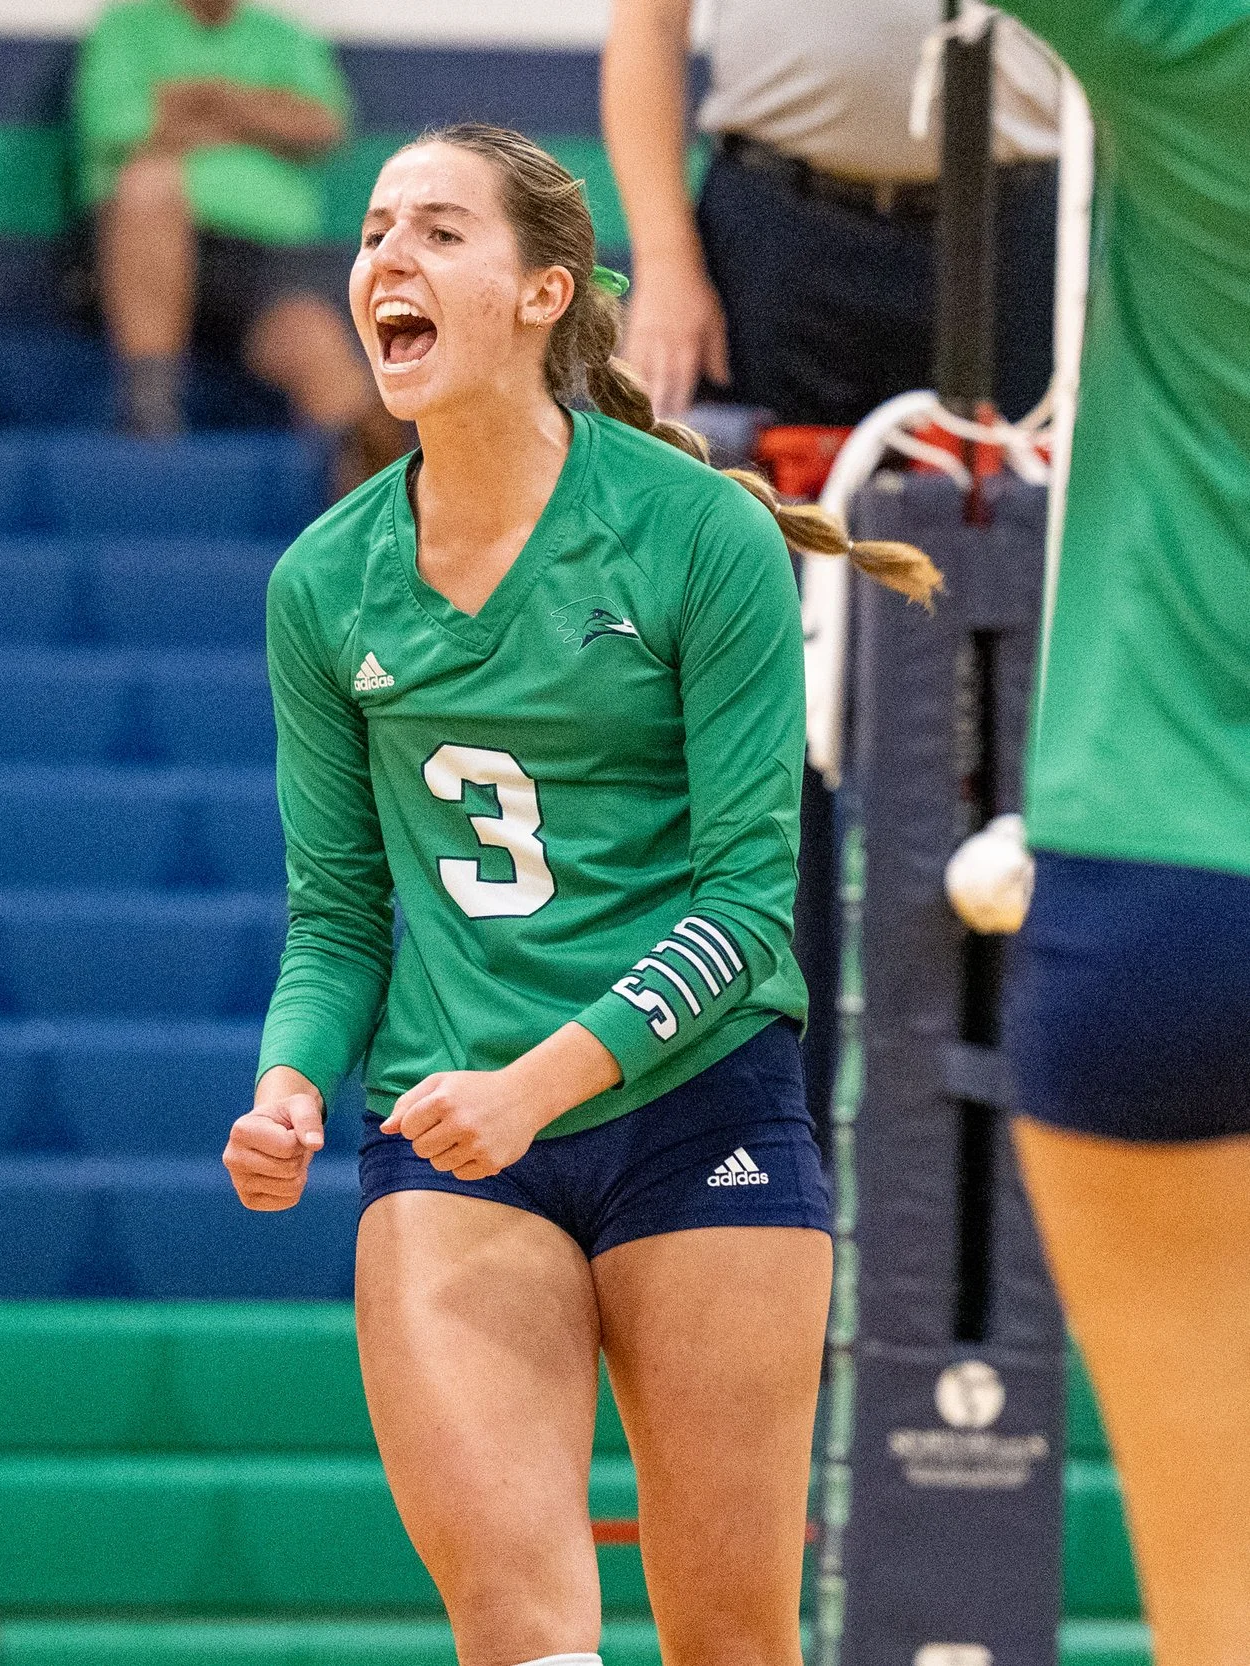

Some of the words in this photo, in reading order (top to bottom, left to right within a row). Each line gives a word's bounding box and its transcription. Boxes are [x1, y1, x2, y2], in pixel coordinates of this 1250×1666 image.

[353, 674, 395, 692] adidas
[421, 738, 559, 921] 3
[610, 914, 747, 1045] ULLS
[706, 1170, 770, 1187] adidas
